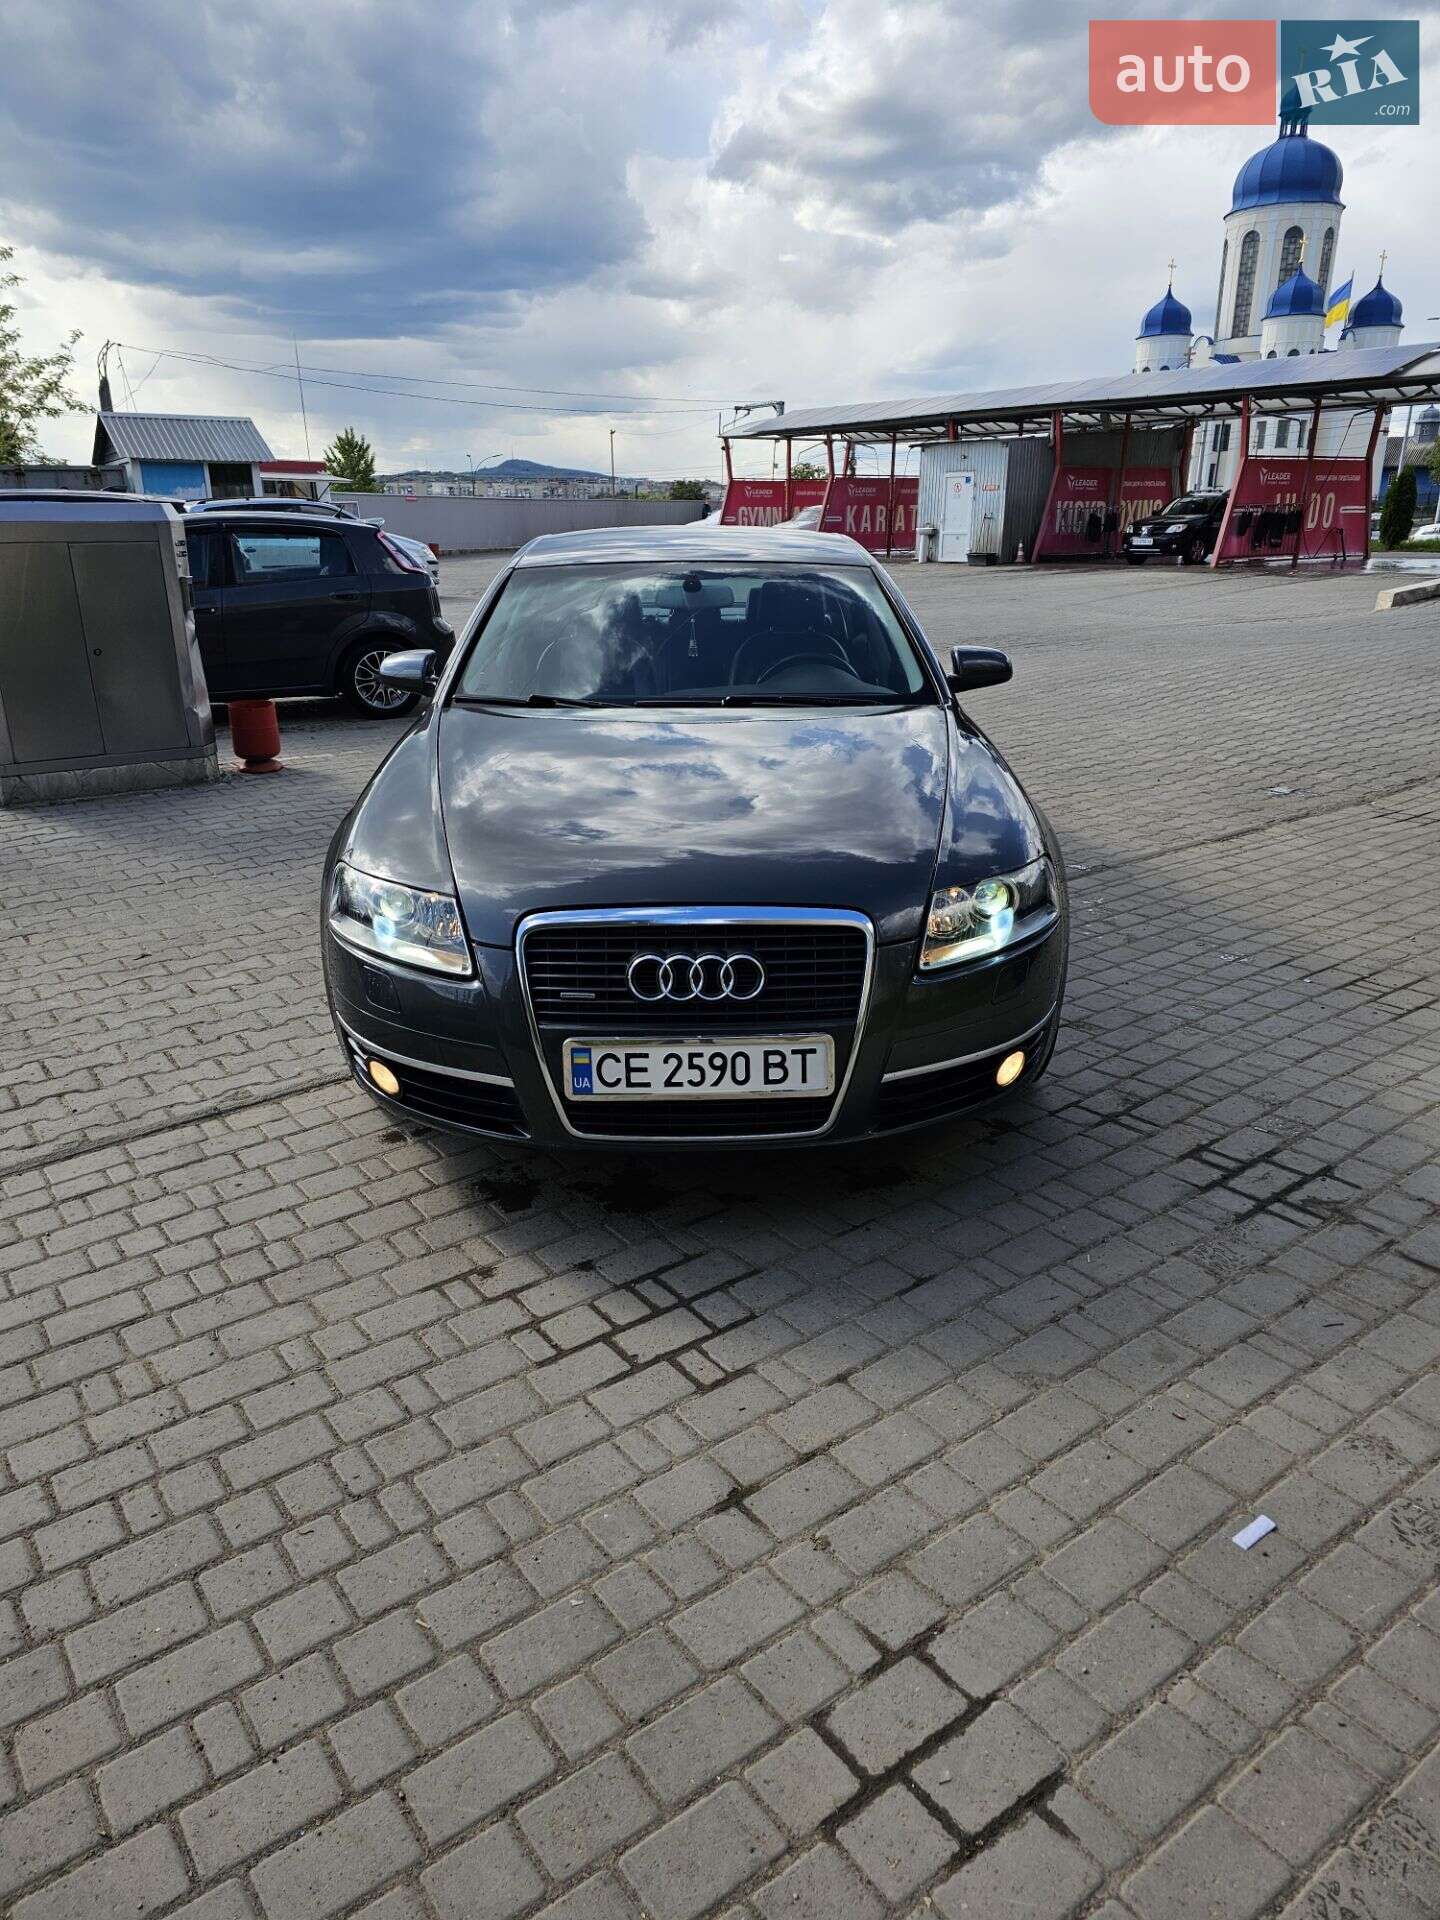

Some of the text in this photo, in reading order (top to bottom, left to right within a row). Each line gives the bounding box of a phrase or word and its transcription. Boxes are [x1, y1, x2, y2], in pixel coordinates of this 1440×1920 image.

[596, 1048, 817, 1089] CE 2590 BT
[574, 1077, 591, 1089] UA
